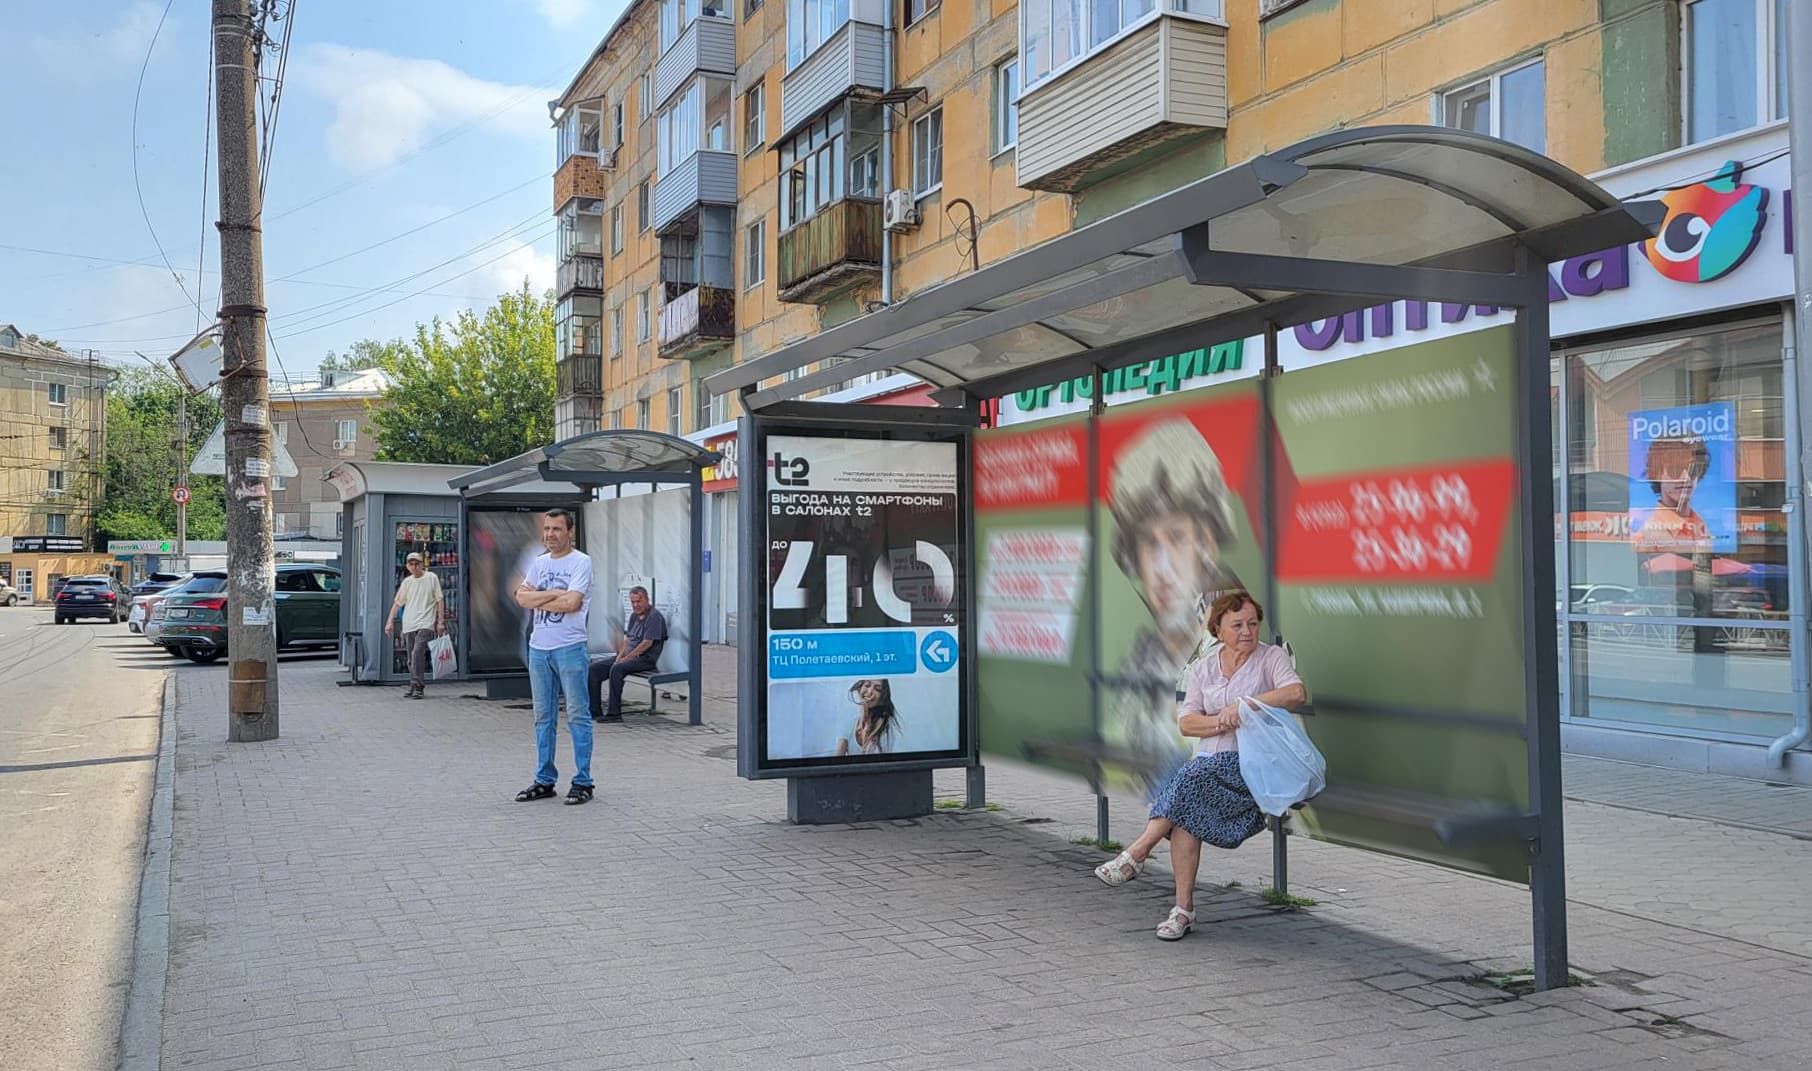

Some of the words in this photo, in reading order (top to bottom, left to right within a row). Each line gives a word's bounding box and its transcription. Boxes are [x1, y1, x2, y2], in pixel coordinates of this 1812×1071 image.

[1633, 409, 1729, 440] Polaroid
[768, 452, 810, 487] t2
[772, 493, 828, 506] ВЫГОДА
[833, 495, 851, 505] НА
[855, 495, 943, 506] СМАРТФОНЫ
[772, 505, 781, 516] В
[785, 505, 851, 517] САЛОНАХ
[855, 505, 873, 517] t2
[772, 638, 803, 651] 150
[772, 655, 789, 666] ТЦ
[790, 653, 874, 665] Полетаевский,
[875, 652, 881, 662] 1
[883, 653, 897, 662] эт.
